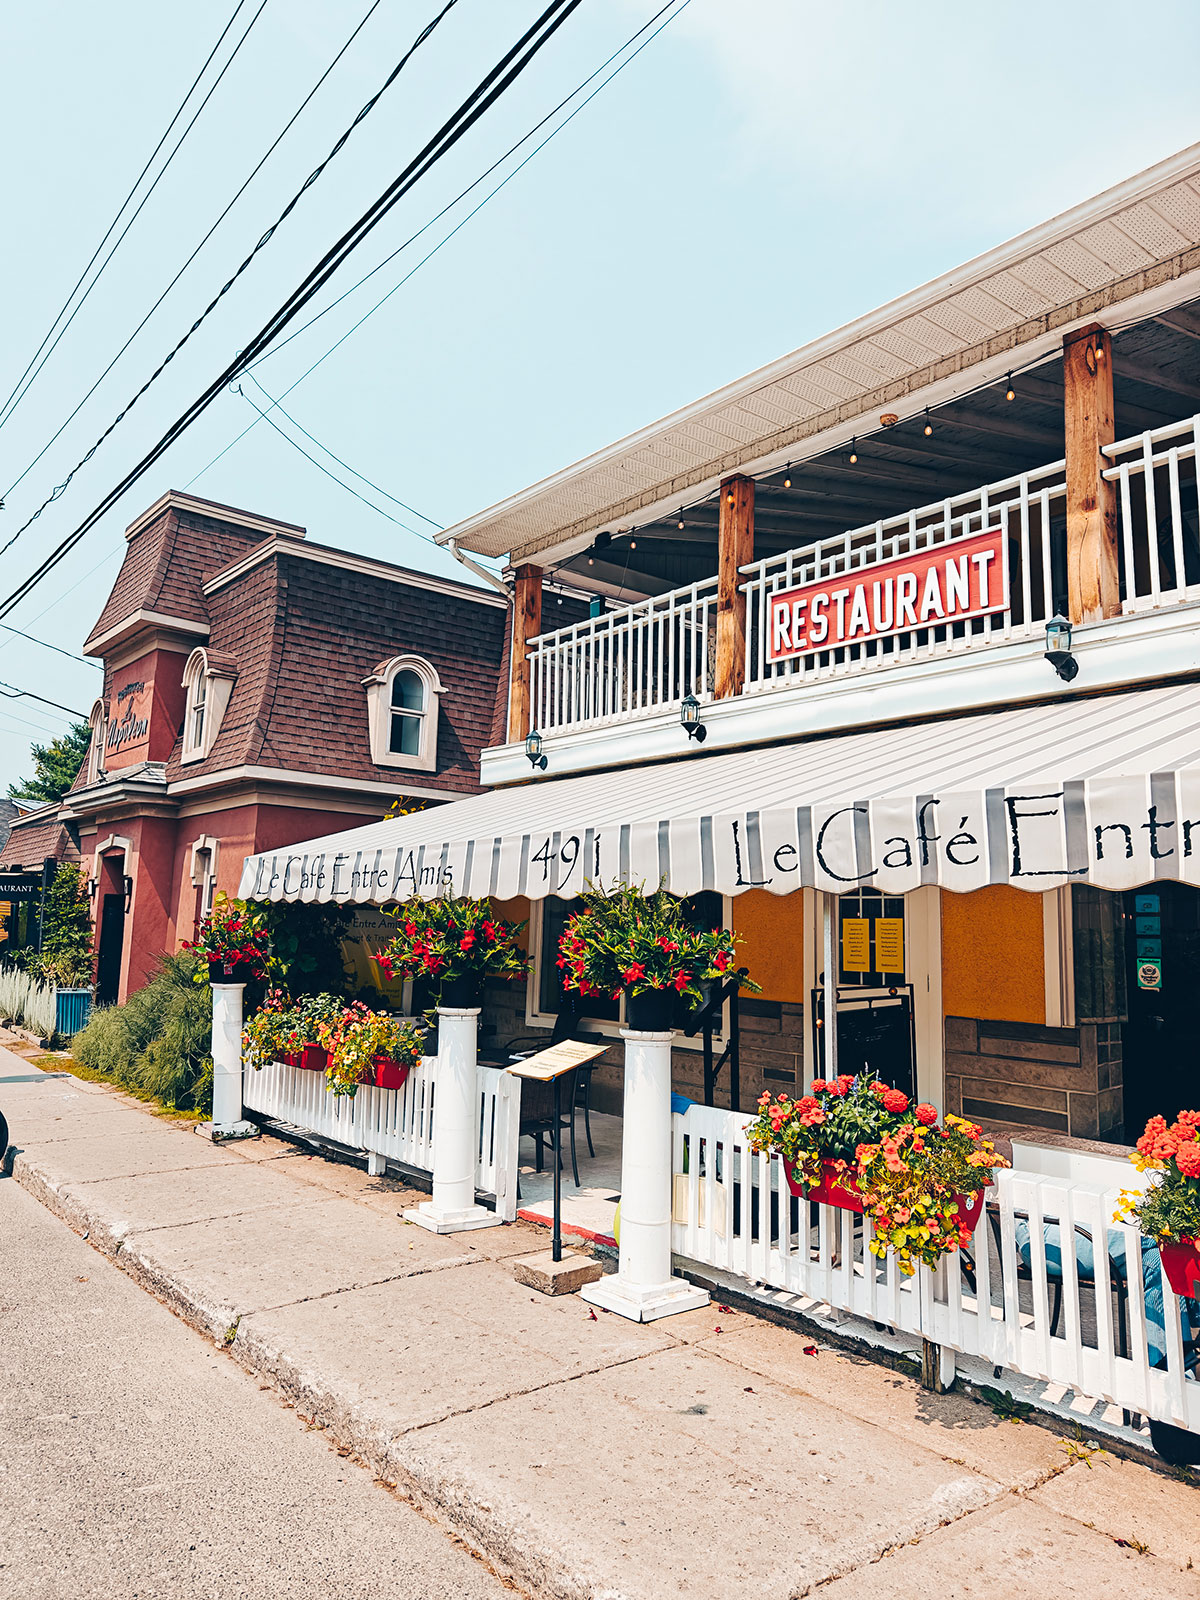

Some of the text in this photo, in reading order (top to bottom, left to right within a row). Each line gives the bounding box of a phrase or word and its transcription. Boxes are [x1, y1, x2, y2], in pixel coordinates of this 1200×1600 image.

[773, 549, 995, 652] RESTAURANT
[531, 833, 601, 890] 491
[732, 791, 1200, 886] Le Café Entr
[256, 850, 454, 896] Le Café Entre Amis
[353, 917, 377, 929] Entre
